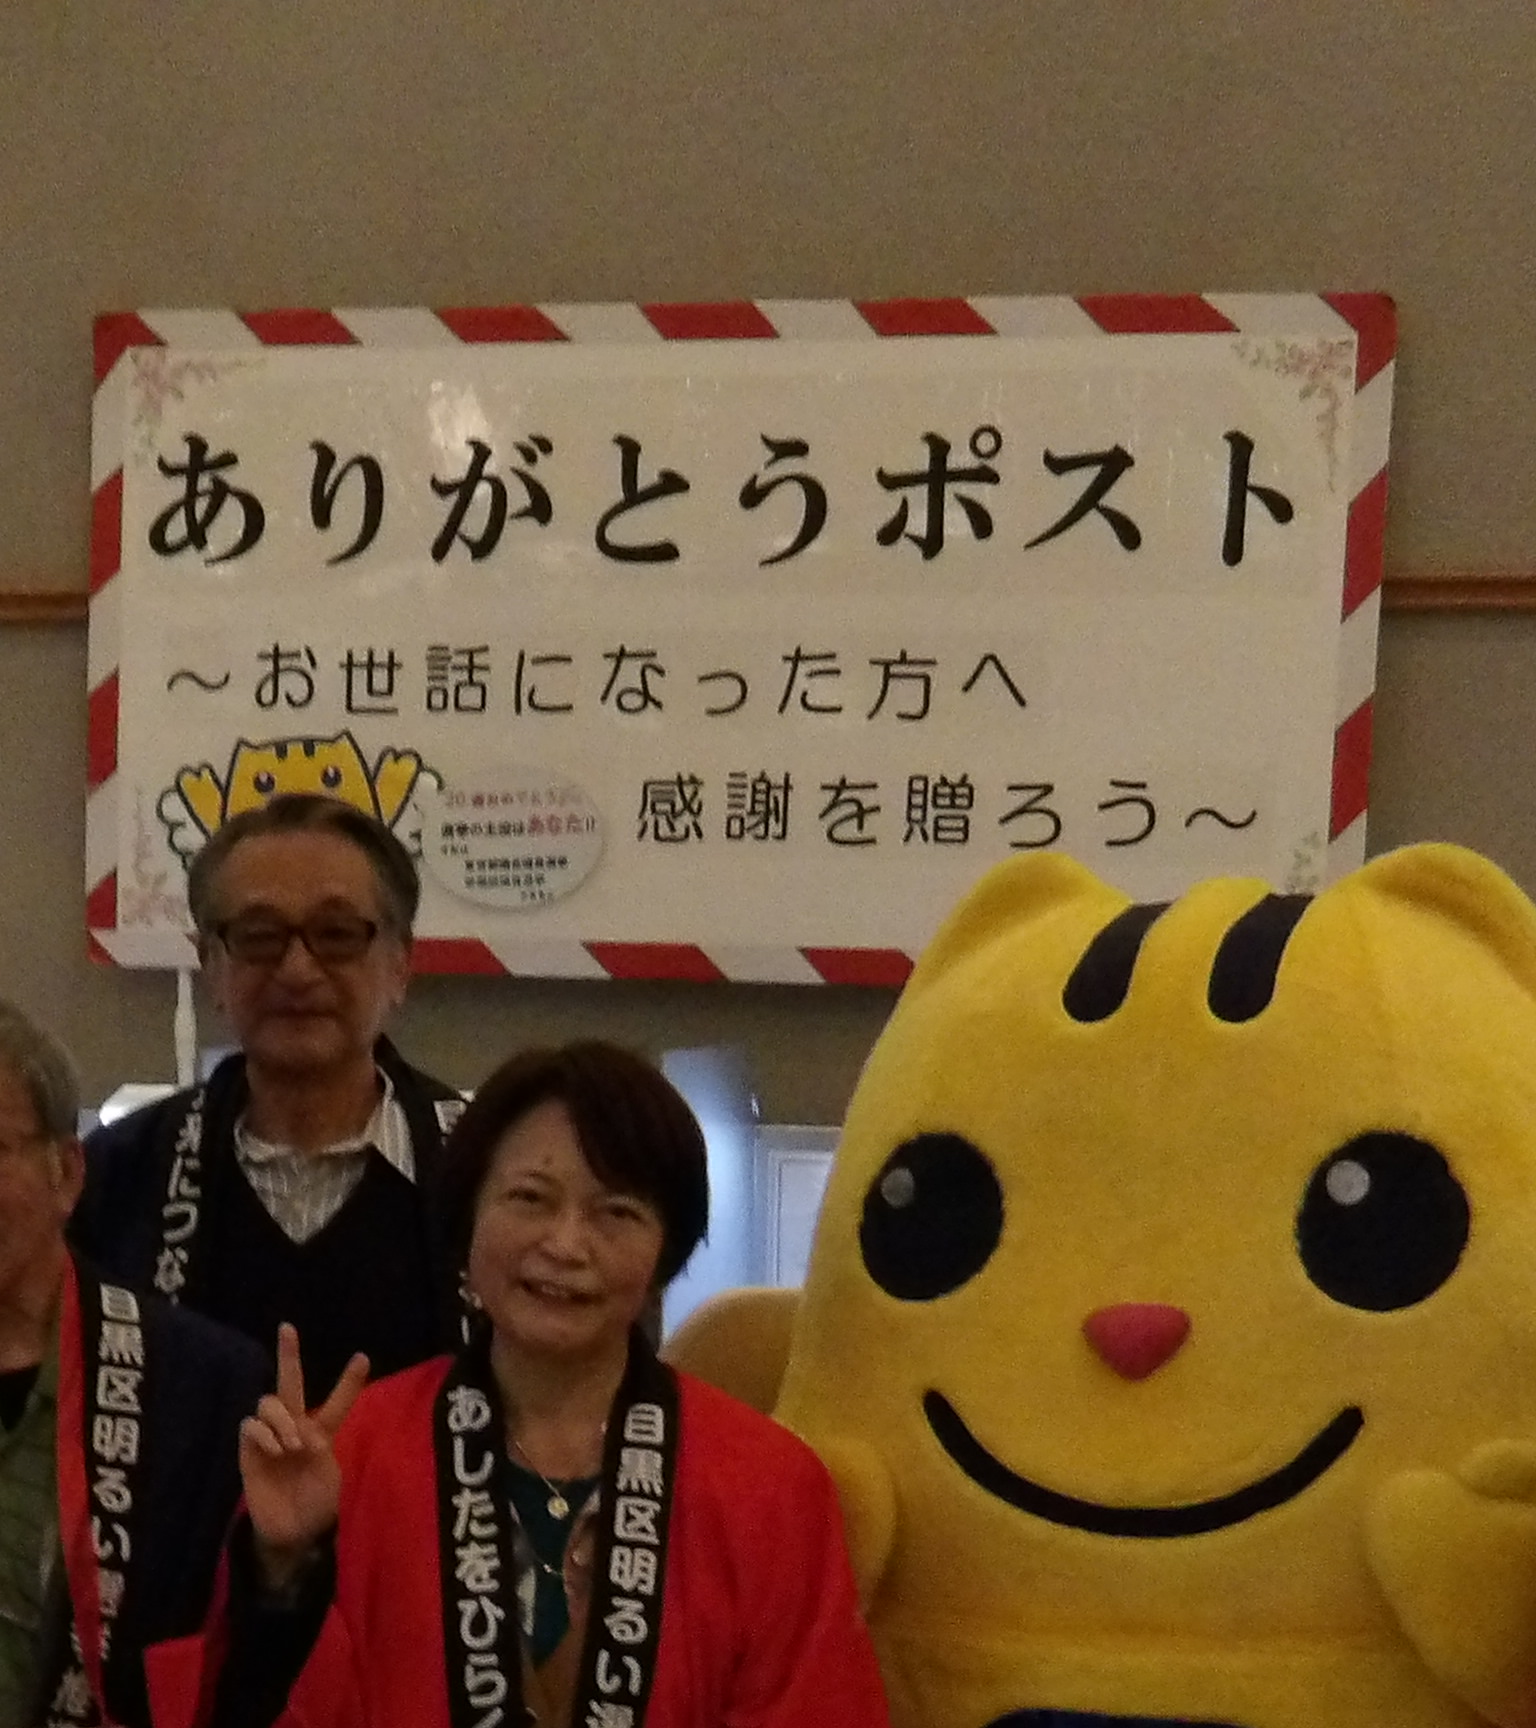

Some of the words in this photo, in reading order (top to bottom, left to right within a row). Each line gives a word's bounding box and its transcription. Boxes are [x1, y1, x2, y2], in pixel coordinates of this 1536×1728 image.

[147, 425, 1297, 567] ありがとうポスト
